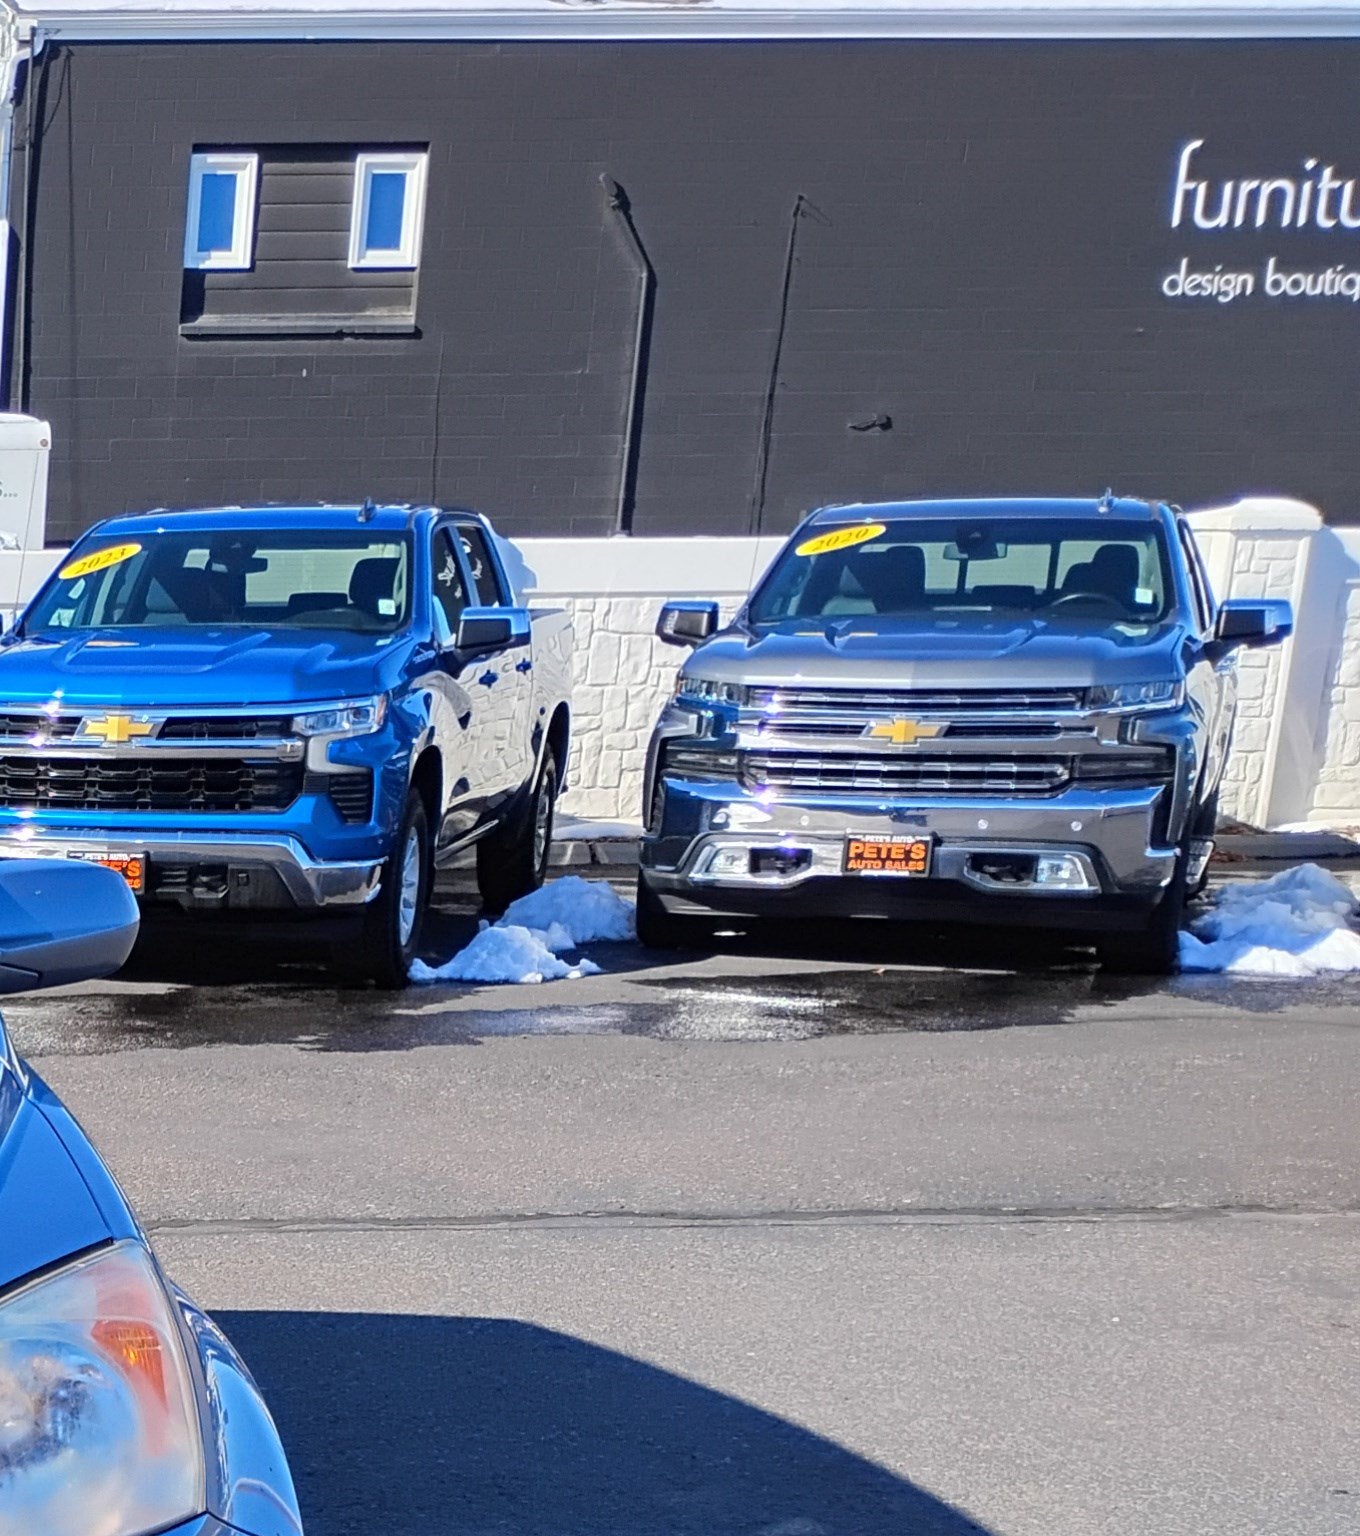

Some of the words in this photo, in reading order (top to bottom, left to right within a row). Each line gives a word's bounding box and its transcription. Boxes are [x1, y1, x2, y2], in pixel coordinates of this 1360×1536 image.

[1161, 257, 1255, 303] design
[849, 842, 926, 859] PETE'S
[847, 859, 882, 869] AUTO
[885, 861, 925, 871] SALES
